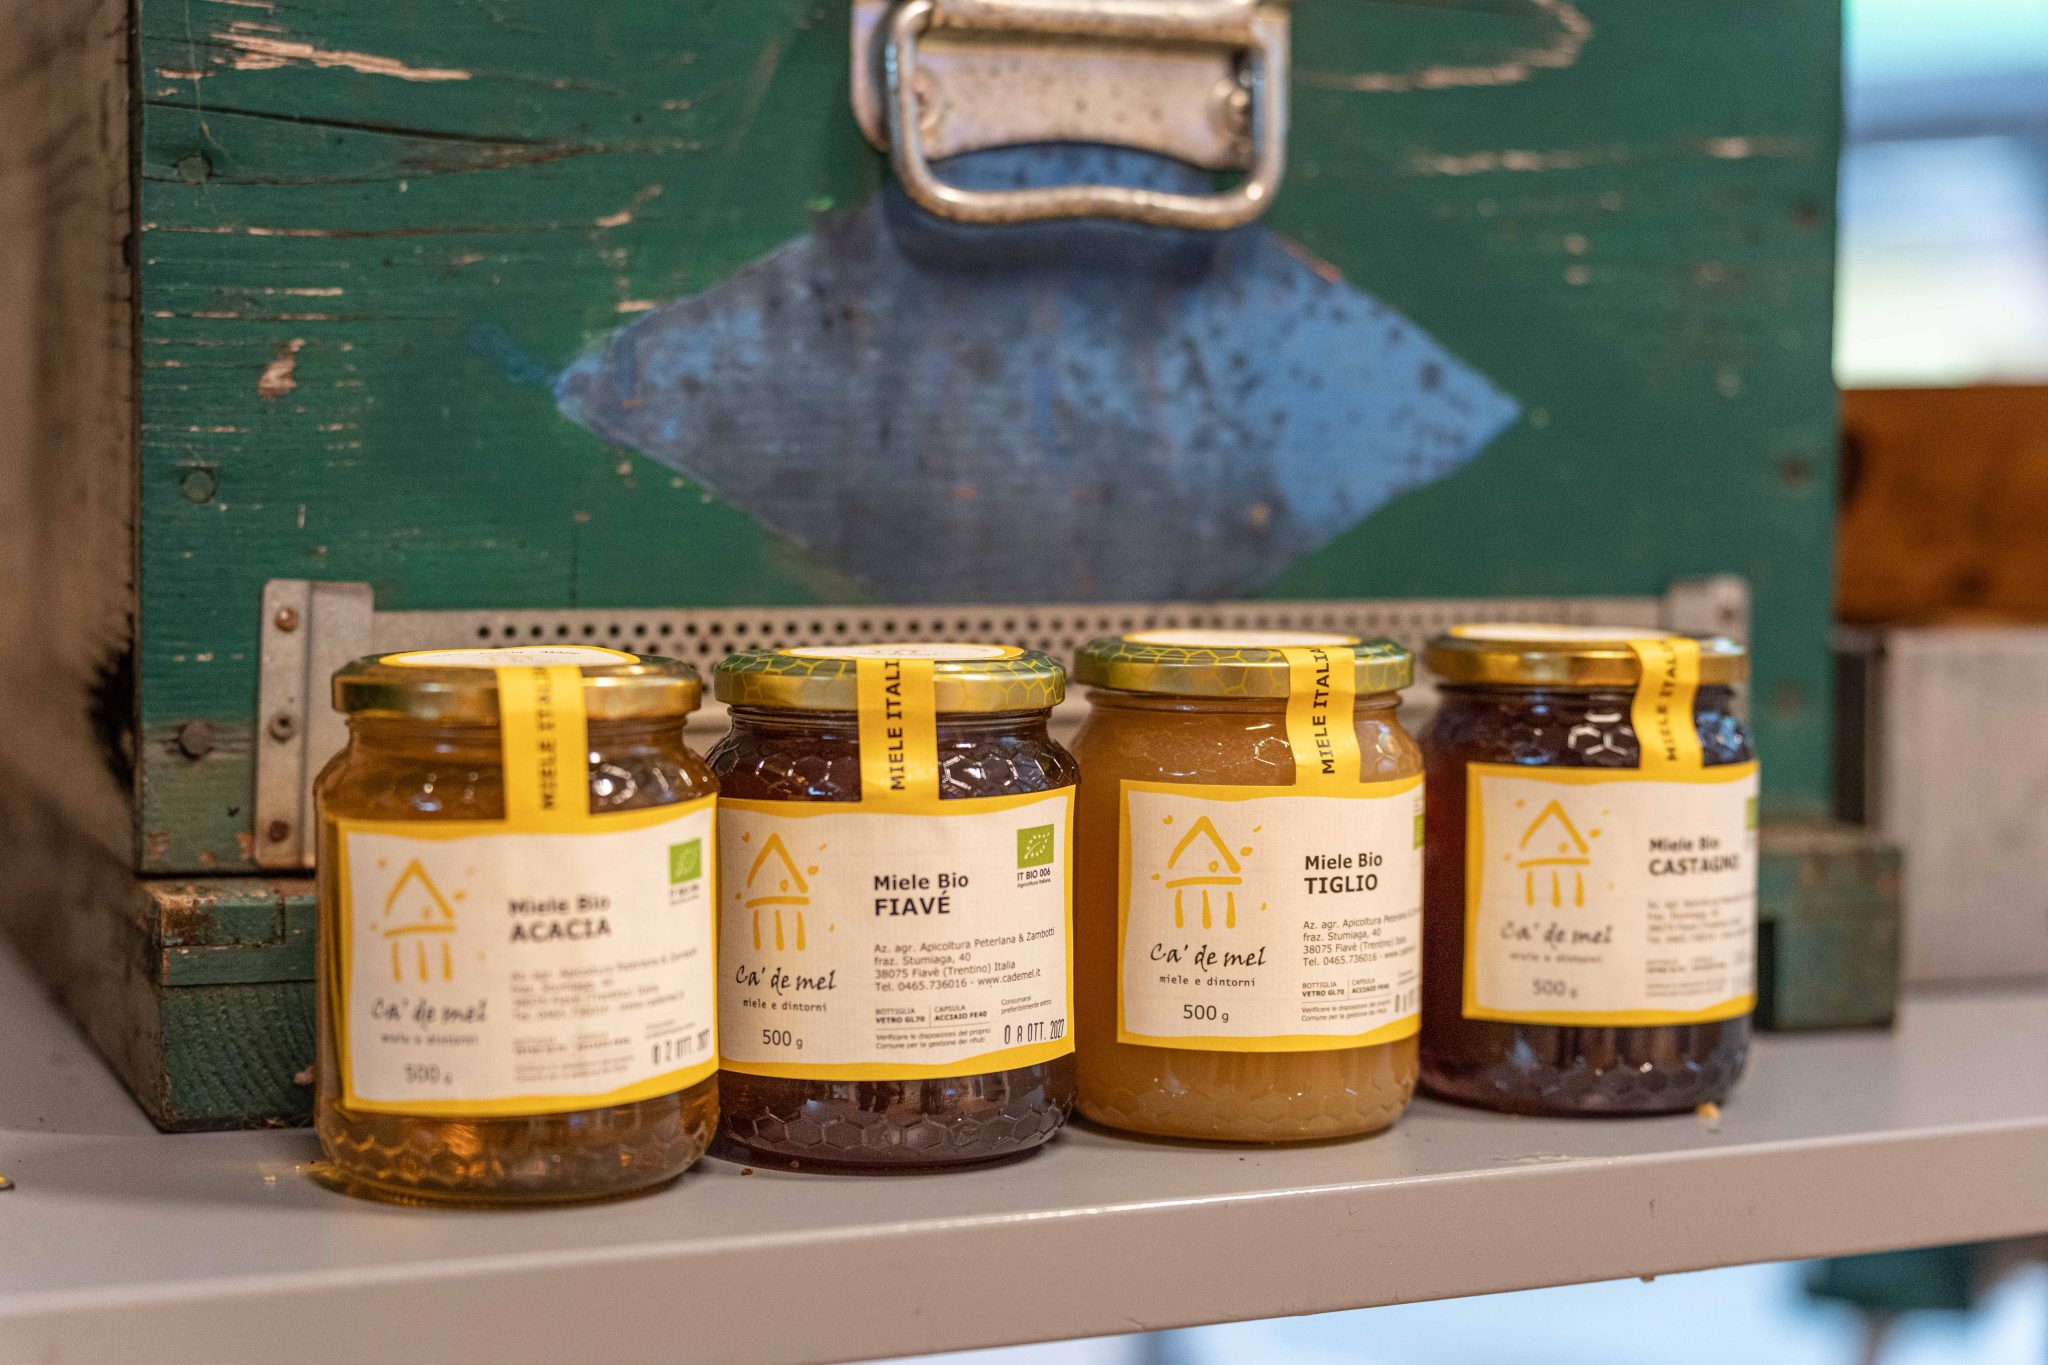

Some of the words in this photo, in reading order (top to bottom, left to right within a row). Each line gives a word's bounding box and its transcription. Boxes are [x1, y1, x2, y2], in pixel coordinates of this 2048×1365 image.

[1312, 715, 1335, 774] MIELE
[888, 728, 906, 791] MIELE
[1649, 837, 1693, 851] Miele
[1699, 836, 1720, 849] Bio
[1305, 854, 1352, 870] Miele
[1358, 852, 1383, 867] Bio
[874, 874, 930, 891] Miele
[938, 872, 969, 888] Bio
[1017, 872, 1024, 881] IT
[1026, 870, 1038, 880] BIO
[1040, 867, 1051, 877] 006
[1304, 874, 1378, 894] TIGLIO
[508, 898, 567, 916] Miele
[577, 893, 611, 912] Bio
[875, 890, 950, 916] FIAVÉ
[511, 917, 611, 943] ACACIA
[1303, 921, 1318, 930] Az.
[1321, 921, 1339, 931] agr.
[1342, 917, 1382, 928] Apicoltura
[874, 944, 891, 953] Az.
[895, 945, 916, 955] agr.
[921, 941, 971, 953] Apicoltura
[1019, 933, 1024, 943] &
[1026, 927, 1055, 941] Zambotti
[1303, 933, 1324, 942] fraz.
[1543, 921, 1565, 951] de
[1571, 923, 1613, 945] mel
[874, 957, 898, 966] fraz.
[959, 952, 971, 961] 40
[1150, 942, 1189, 964] Ca'
[1194, 944, 1218, 972] de
[1223, 946, 1266, 967] mel
[1303, 945, 1332, 955] 38075
[1303, 957, 1320, 967] Tel.
[1323, 953, 1377, 966] 0465.736016
[875, 968, 909, 979] 38075
[943, 963, 991, 978] (Trentino)
[994, 961, 1015, 972] Italia
[736, 965, 766, 986] Ca'
[770, 967, 791, 996] de
[796, 970, 838, 991] mel
[875, 982, 894, 992] Tel.
[898, 978, 968, 991] 0465.736016
[978, 968, 1041, 985] www.cademel.it
[1160, 975, 1189, 985] miele
[1207, 977, 1256, 987] dintorni
[1302, 981, 1337, 990] BOTTIGLIA
[1533, 978, 1566, 997] 500
[1302, 990, 1326, 998] VETRO
[743, 998, 767, 1010] miele
[781, 1001, 827, 1012] dintorni
[934, 1005, 966, 1013] CAPSULA
[1183, 1004, 1217, 1021] 500
[1221, 1012, 1229, 1023] g
[875, 1016, 902, 1024] VETRO
[935, 1013, 967, 1021] ACCIAIO
[970, 1010, 987, 1019] FE40
[1301, 1014, 1327, 1022] Comune
[762, 1029, 792, 1047] 500
[796, 1038, 803, 1050] g
[1004, 1024, 1011, 1044] 0
[1028, 1021, 1047, 1042] OTT.
[404, 1062, 440, 1084] 500
